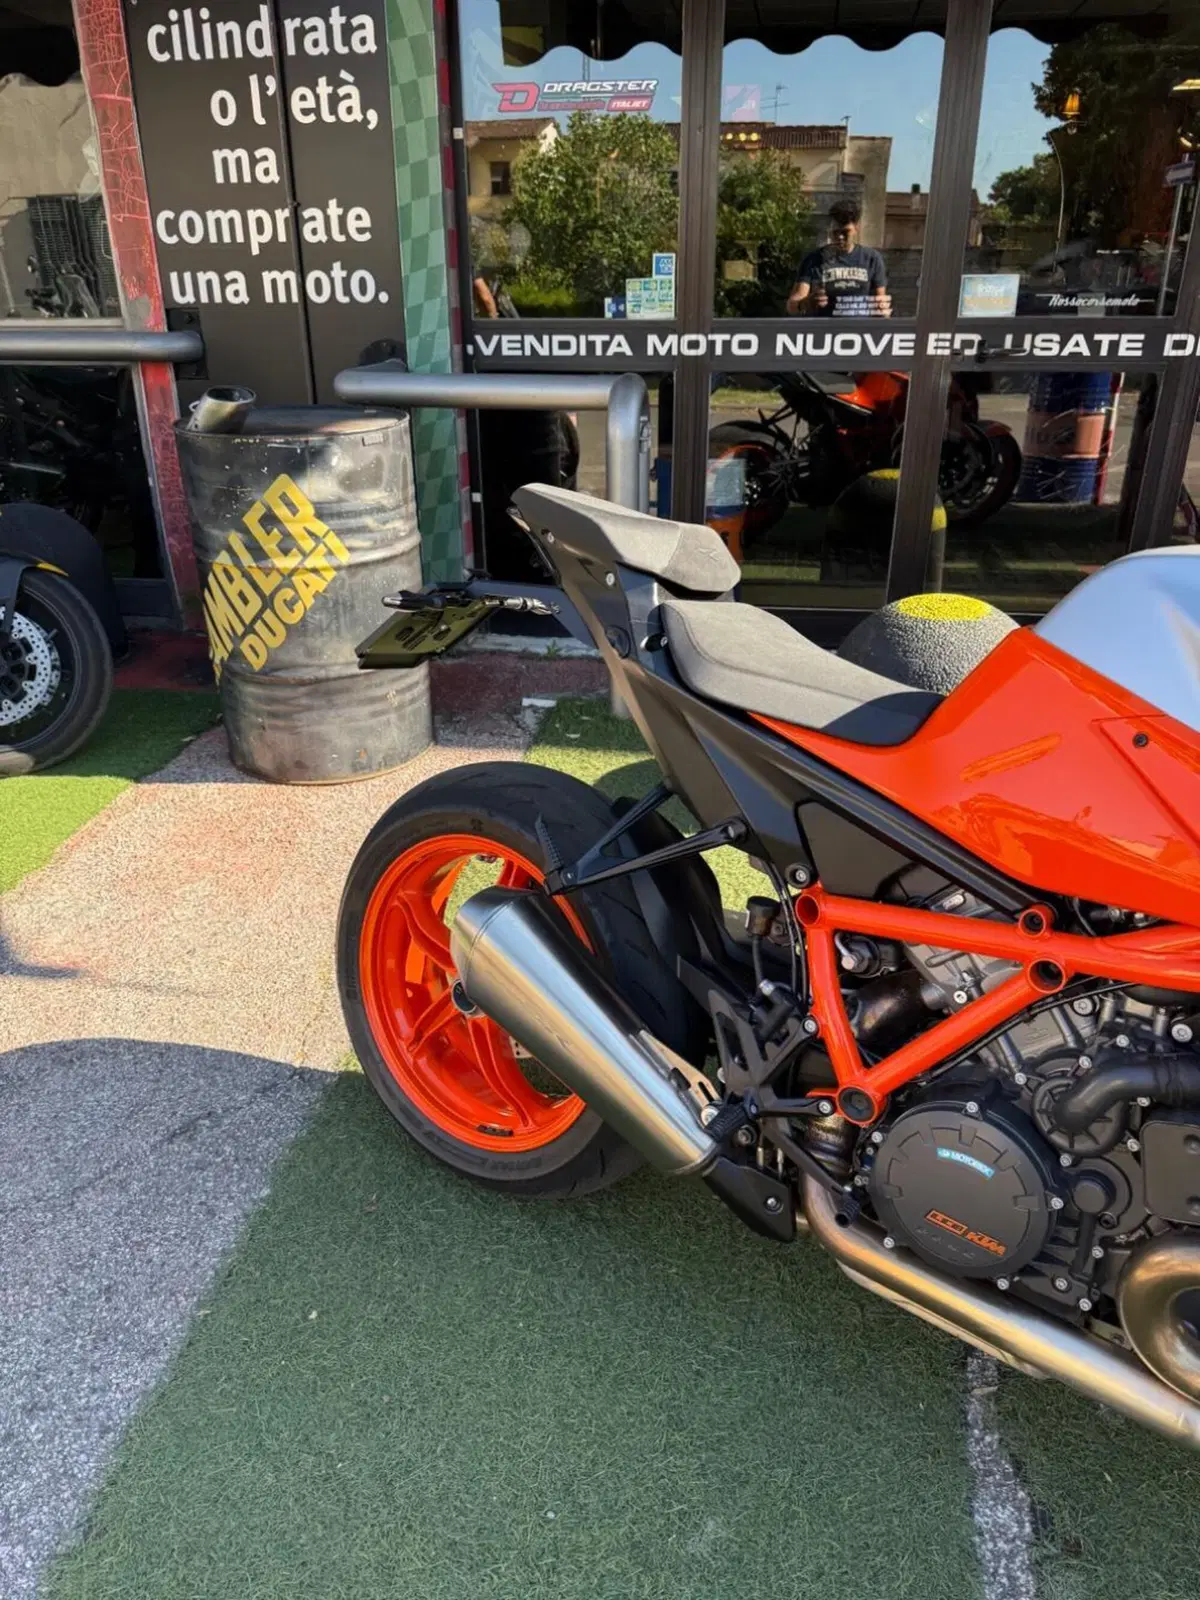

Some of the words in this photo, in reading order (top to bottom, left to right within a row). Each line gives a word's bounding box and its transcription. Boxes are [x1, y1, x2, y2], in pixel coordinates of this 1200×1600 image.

[147, 4, 377, 62] cilindrata
[543, 79, 659, 93] DRAGSTER
[210, 89, 237, 126] o
[212, 146, 280, 184] ma
[156, 198, 372, 255] comprate
[169, 269, 250, 305] una
[262, 260, 389, 304] moto.
[647, 333, 759, 356] MOTO
[775, 333, 916, 356] NUOVE
[1004, 333, 1145, 357] USATE
[203, 473, 331, 686] AMBLER
[240, 531, 351, 671] DUCATI
[966, 1231, 1006, 1256] KTM
